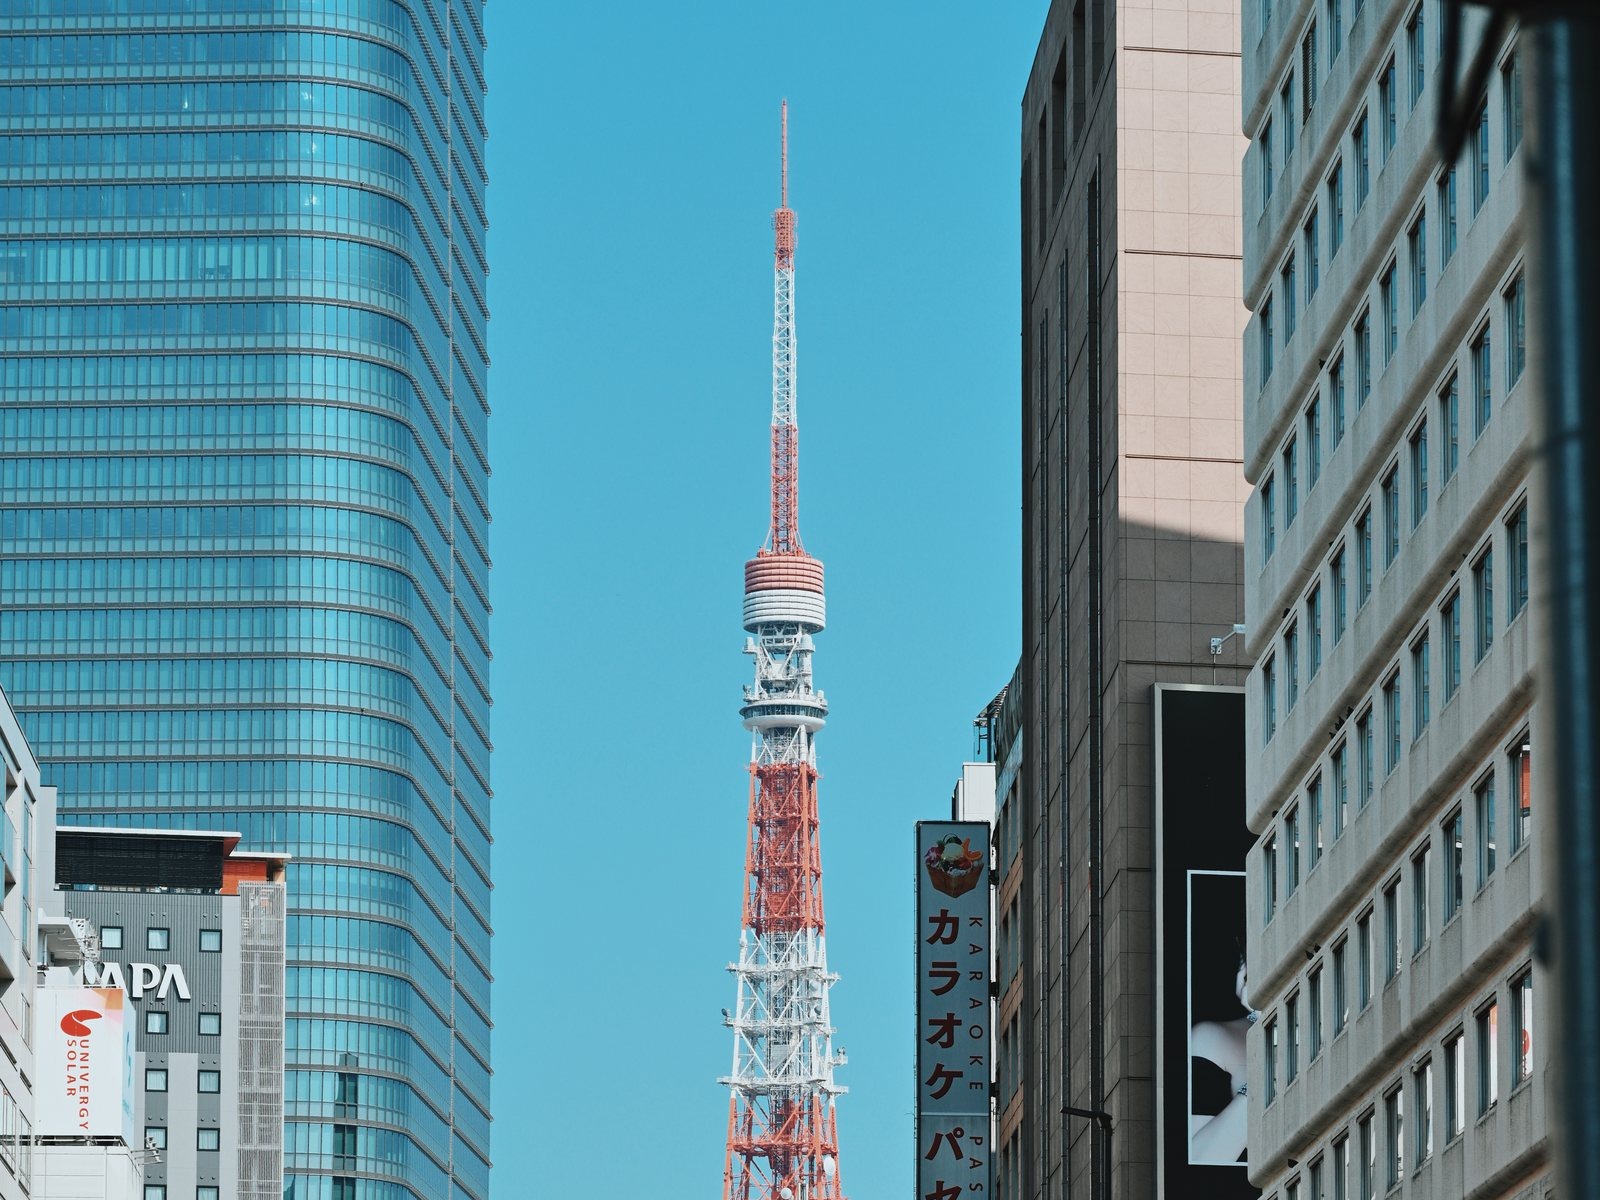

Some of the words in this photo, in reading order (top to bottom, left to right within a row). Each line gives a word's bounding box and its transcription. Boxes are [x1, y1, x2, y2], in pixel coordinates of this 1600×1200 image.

[99, 962, 191, 1000] APA
[925, 909, 963, 1100] カラオケ
[969, 917, 983, 1090] KARAOKE
[67, 1039, 77, 1097] SOLAR
[79, 1040, 89, 1130] UNIVERGY
